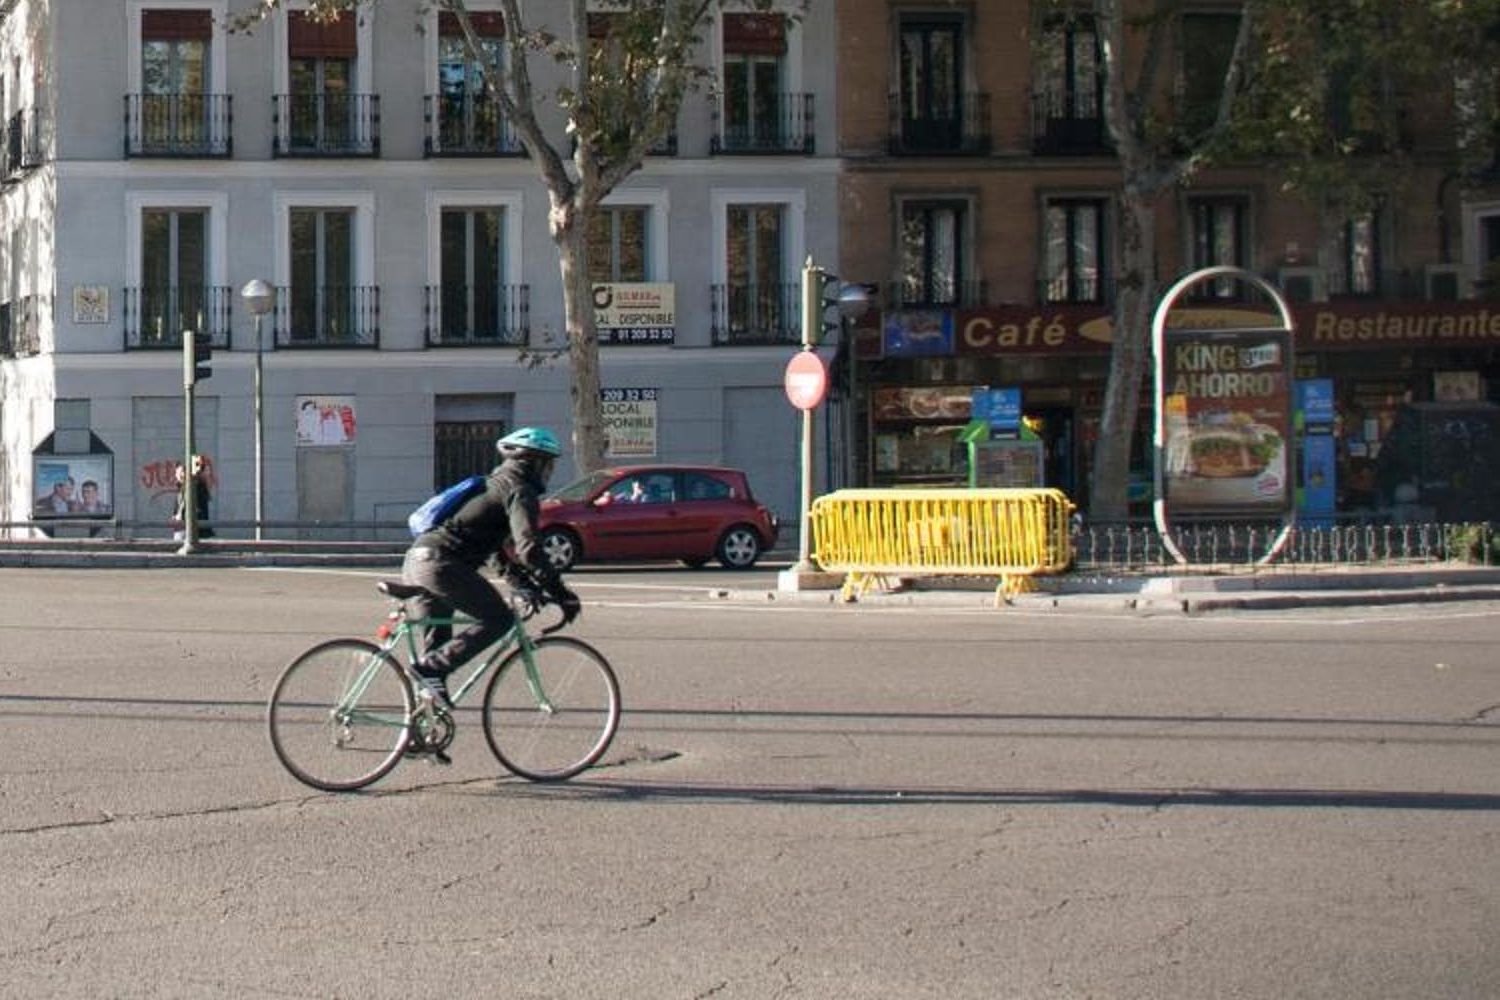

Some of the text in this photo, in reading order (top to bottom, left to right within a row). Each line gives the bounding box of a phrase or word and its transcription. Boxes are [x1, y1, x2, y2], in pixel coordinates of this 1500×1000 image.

[619, 312, 674, 325] DISPONIBLE
[963, 315, 1067, 348] Café
[1314, 309, 1500, 341] Restaurante
[1175, 342, 1237, 372] KING
[1174, 372, 1273, 399] AHORRO
[601, 402, 641, 415] LOCAL
